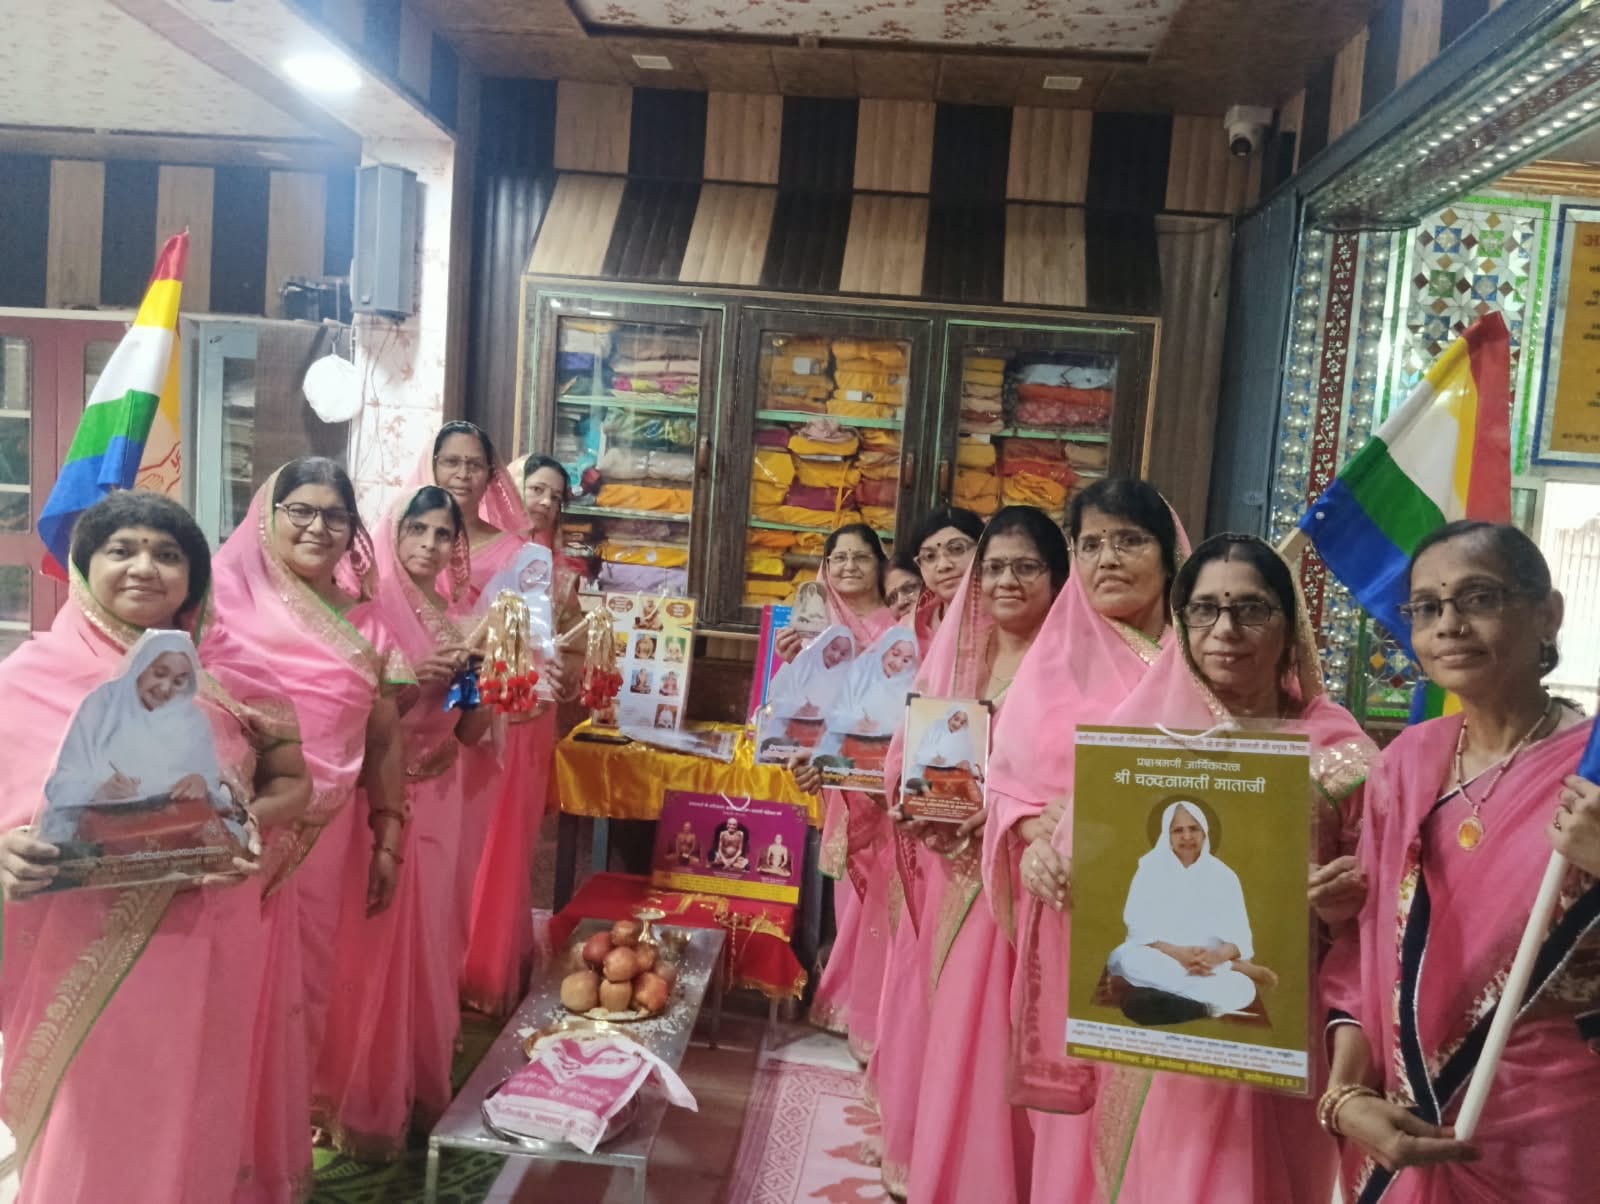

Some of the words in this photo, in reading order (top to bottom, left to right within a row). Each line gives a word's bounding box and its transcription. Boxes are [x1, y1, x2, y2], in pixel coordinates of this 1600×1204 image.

[1113, 769, 1131, 785] श्री
[1135, 773, 1209, 790] चन्दनामती
[1214, 776, 1266, 793] माताजी
